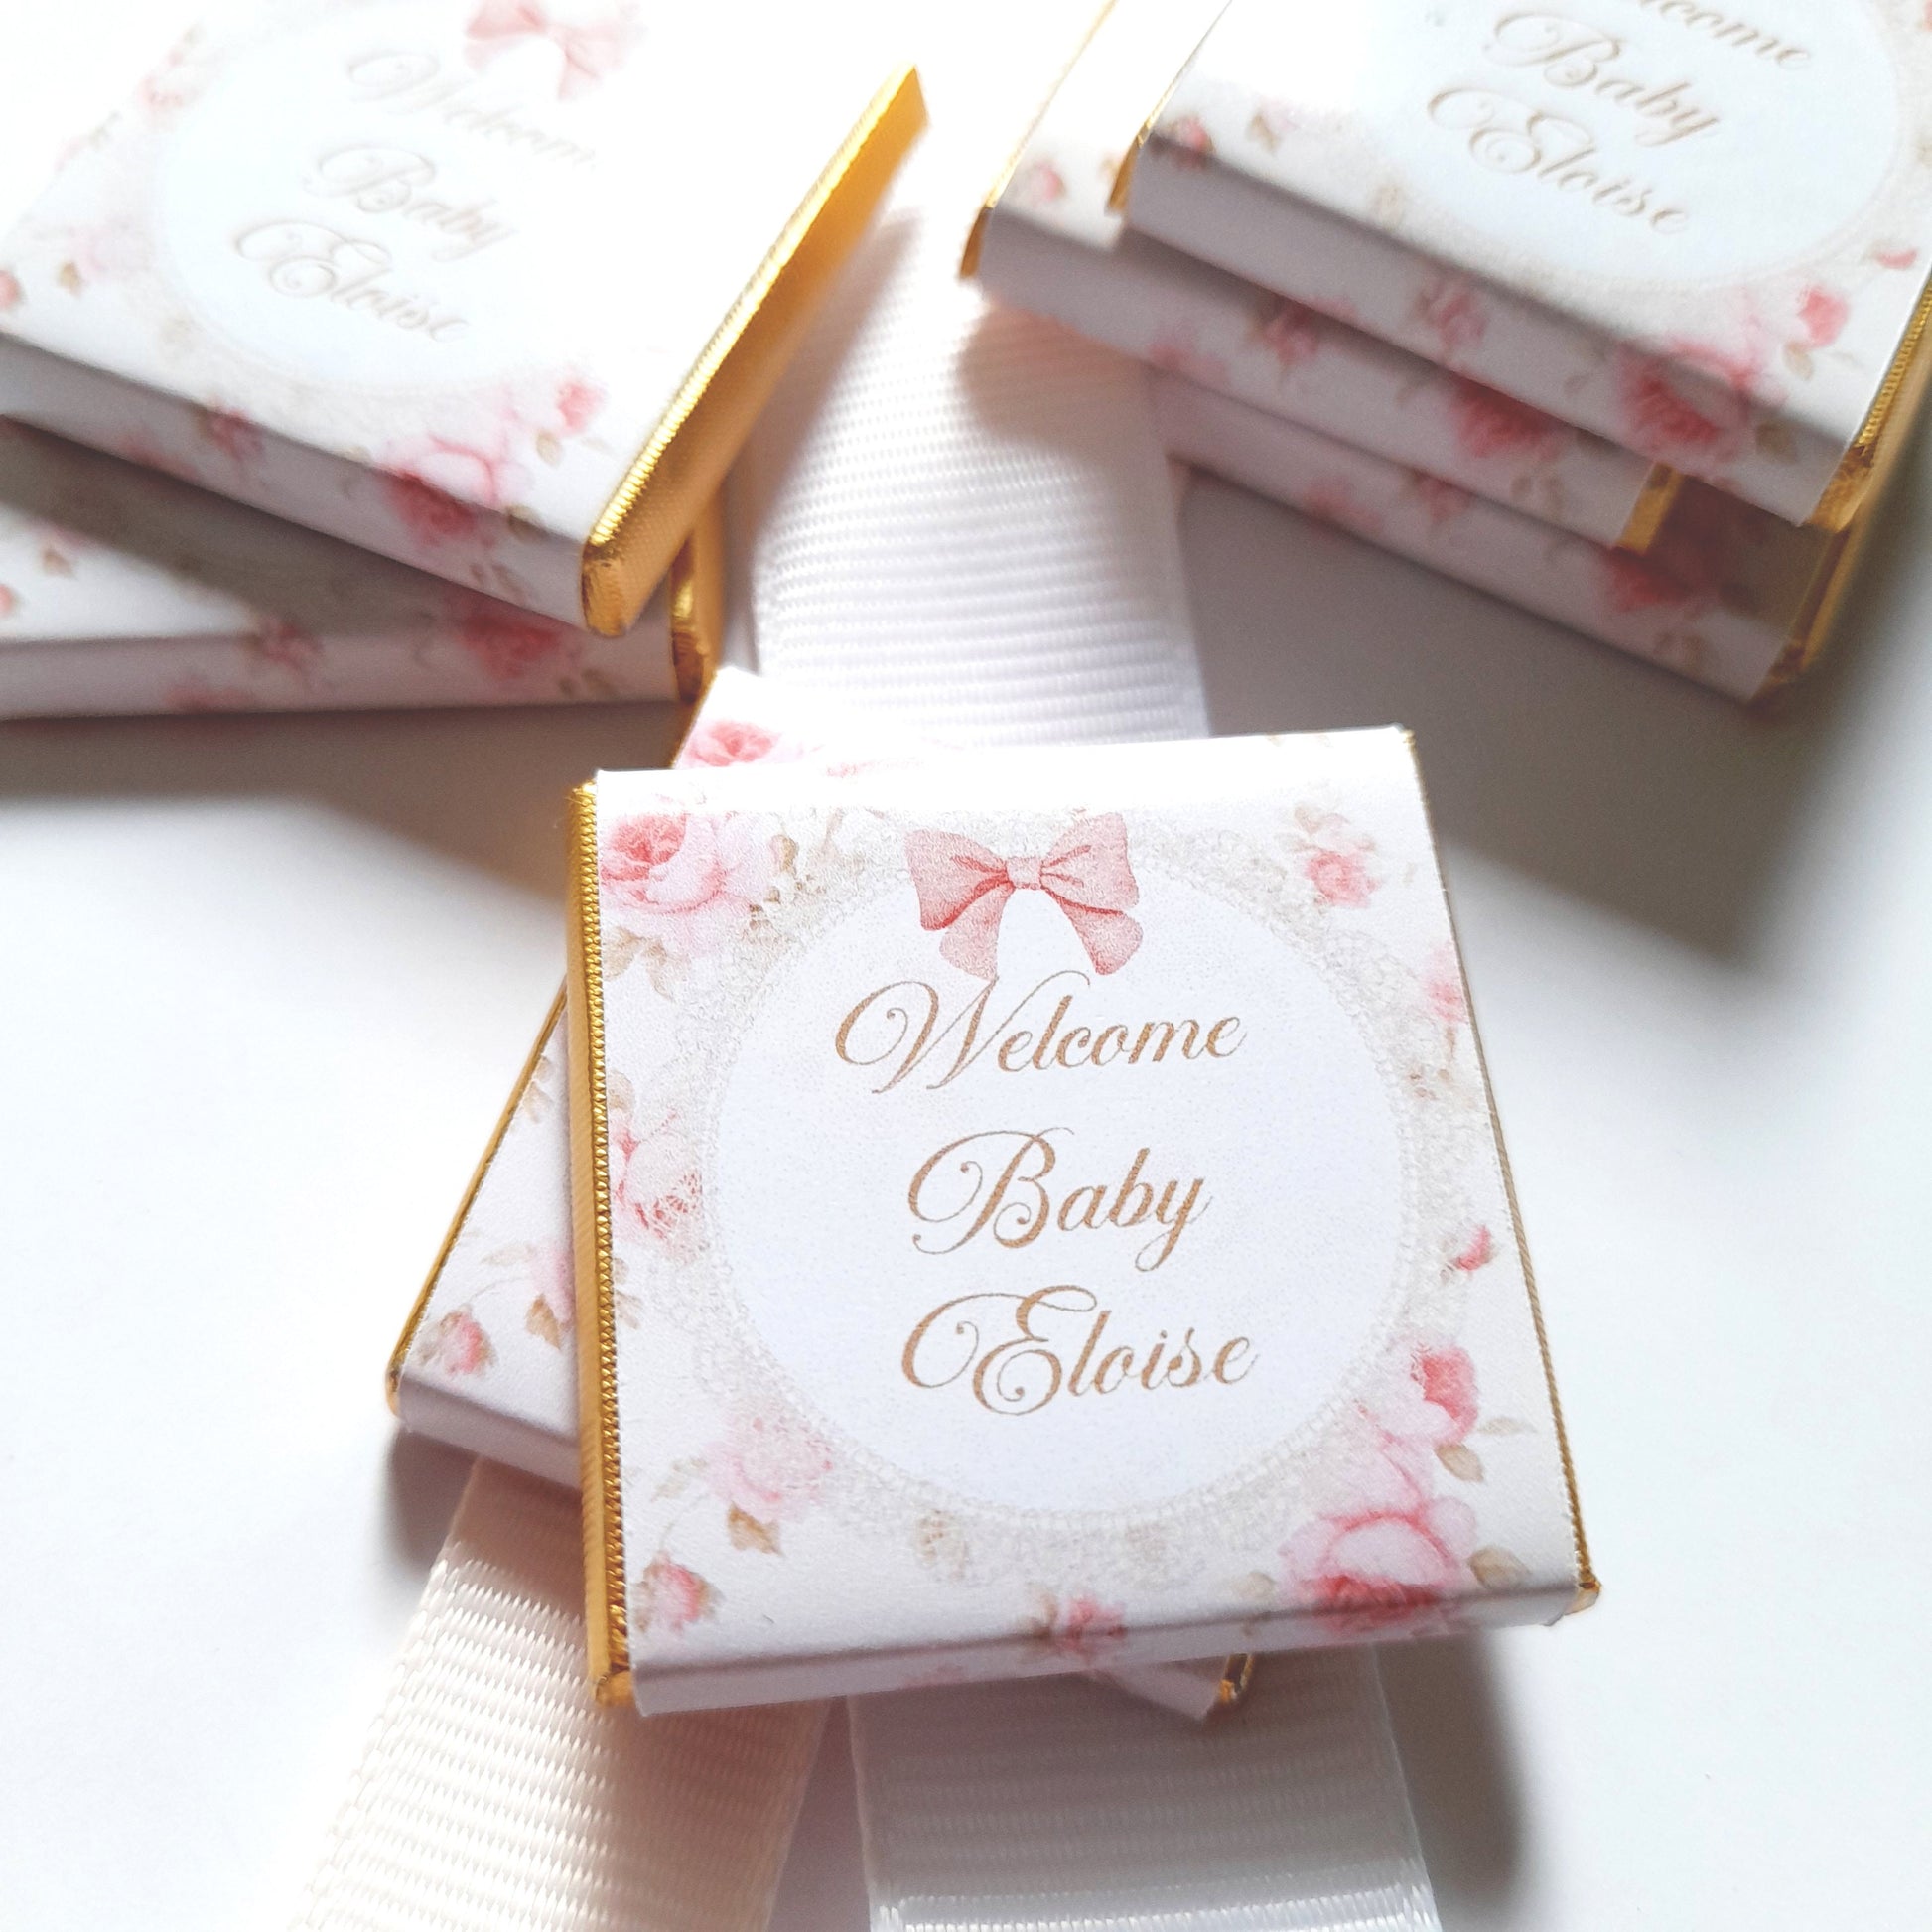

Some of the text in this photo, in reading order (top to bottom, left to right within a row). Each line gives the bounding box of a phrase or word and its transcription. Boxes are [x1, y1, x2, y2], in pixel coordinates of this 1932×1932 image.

[347, 48, 598, 173] Welcom
[1484, 11, 1720, 147] Baby
[301, 144, 519, 263] Baby
[1427, 87, 1689, 235] Eloise
[233, 220, 470, 344] Eloise
[835, 970, 1248, 1093] Welcome
[907, 1127, 1213, 1272] Baby
[901, 1285, 1258, 1416] Eloise
